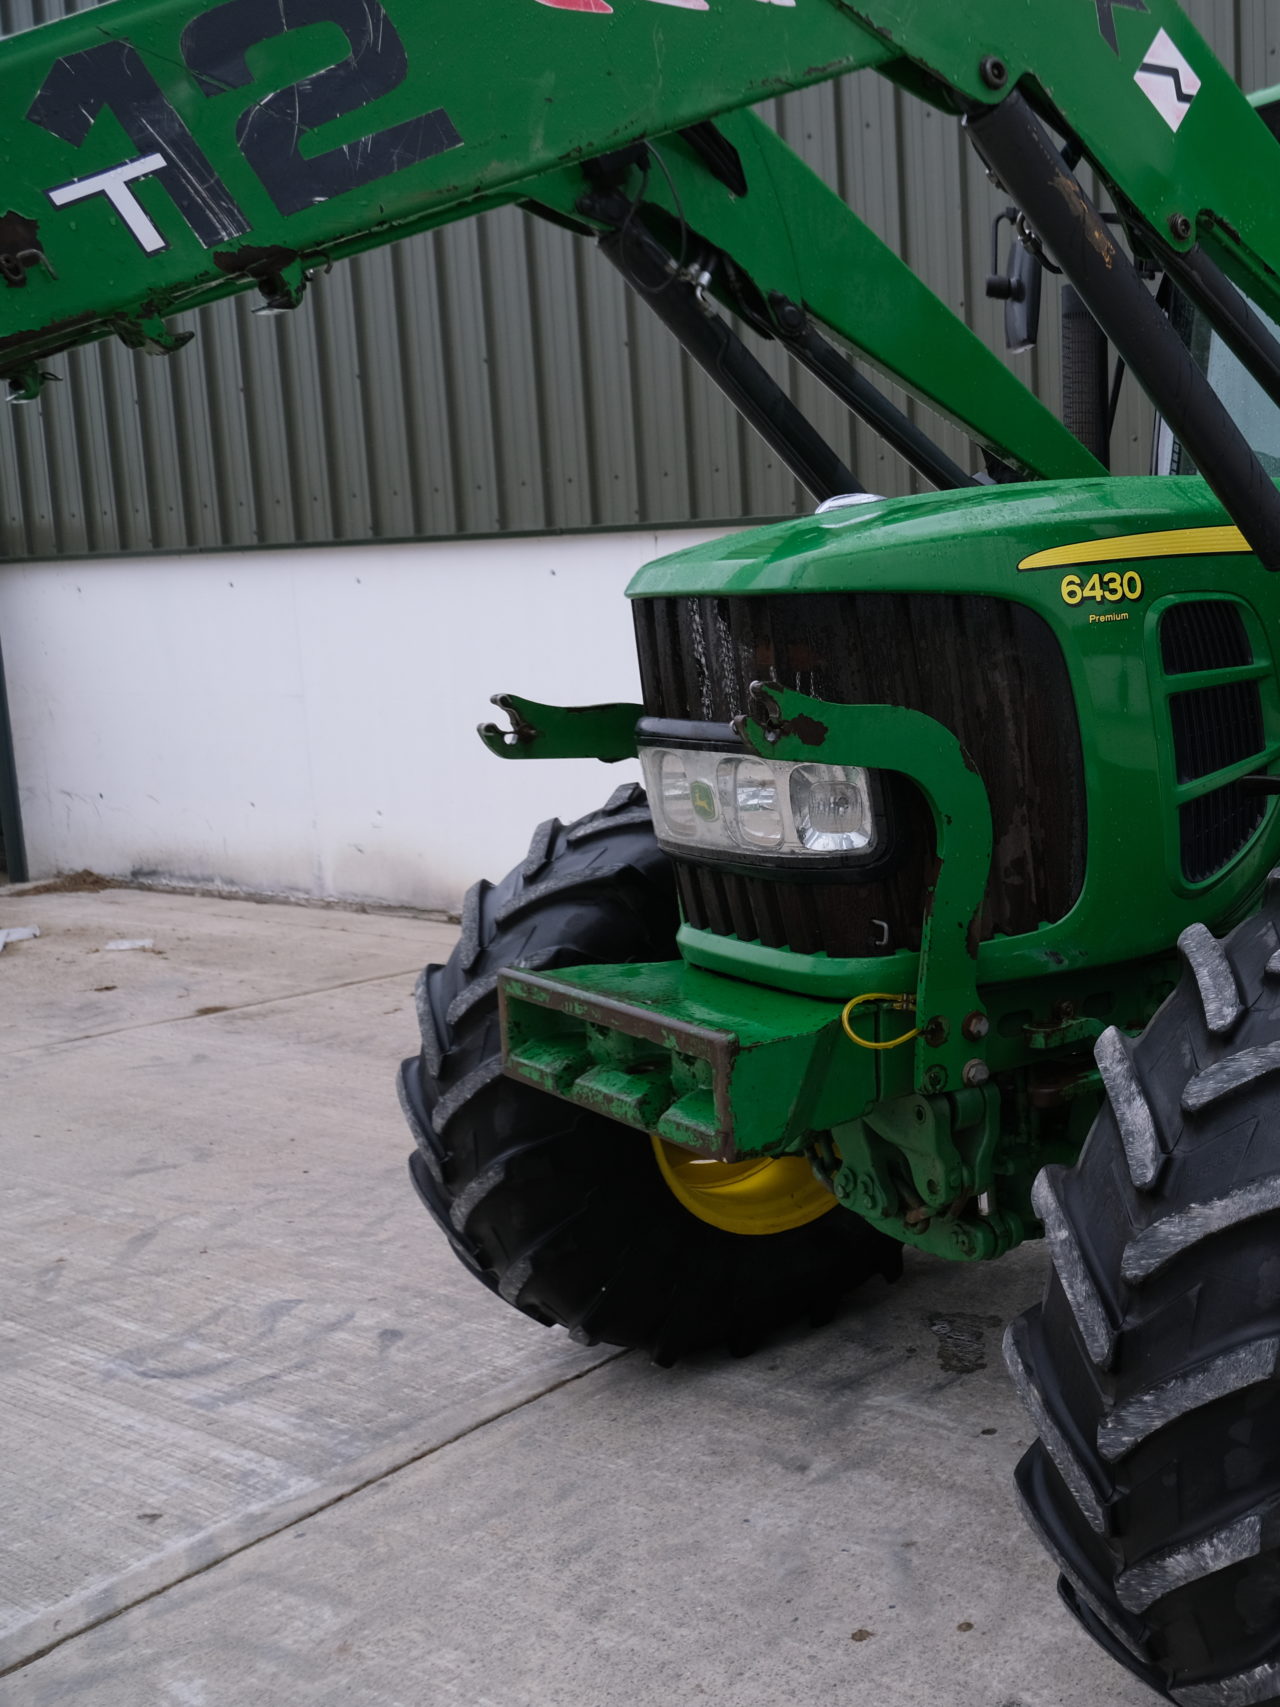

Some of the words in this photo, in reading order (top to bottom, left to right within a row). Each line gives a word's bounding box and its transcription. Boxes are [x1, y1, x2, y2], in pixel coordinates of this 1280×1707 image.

[25, 0, 464, 249] 12
[42, 151, 169, 258] T
[1061, 570, 1142, 606] 6430
[1089, 612, 1129, 624] Premium
